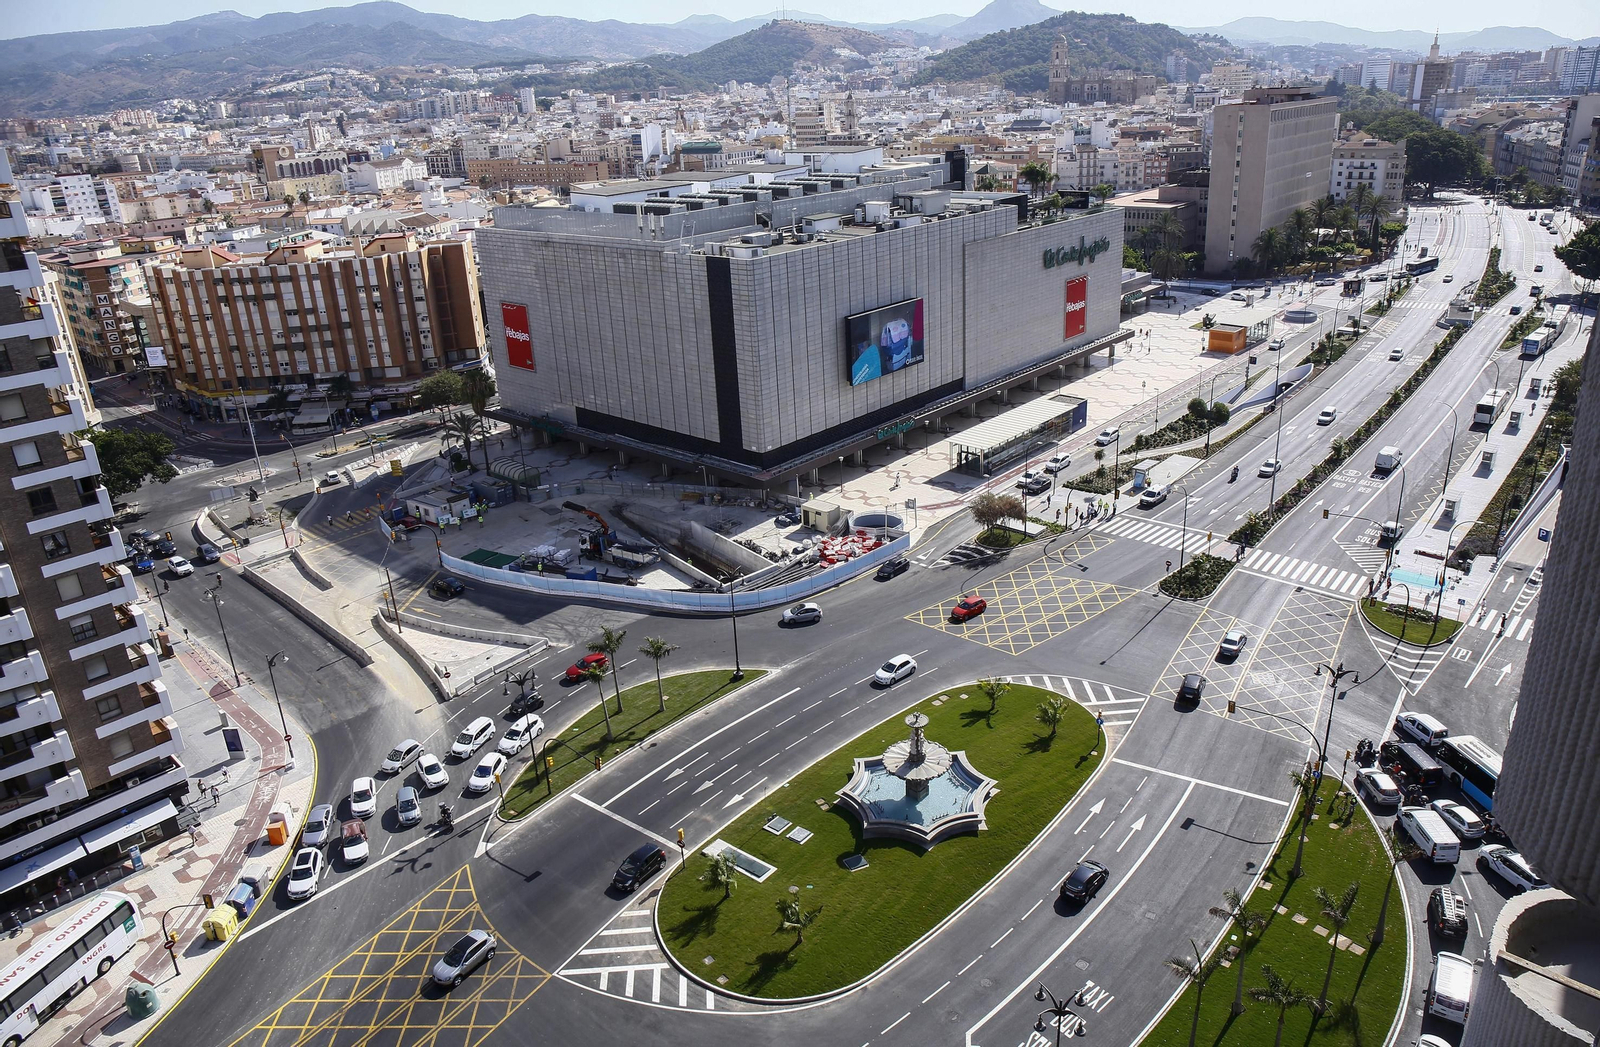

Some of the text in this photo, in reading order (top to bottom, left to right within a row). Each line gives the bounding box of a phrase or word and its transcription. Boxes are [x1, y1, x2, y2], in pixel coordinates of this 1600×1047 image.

[1066, 300, 1086, 313] rebajas
[97, 295, 122, 354] MANGO
[506, 328, 530, 342] rebajas
[1364, 528, 1382, 537] BUS
[1355, 535, 1378, 546] SOLO
[26, 950, 45, 964] DE
[1075, 980, 1115, 1013] TAXI
[1049, 1007, 1087, 1039] BUS
